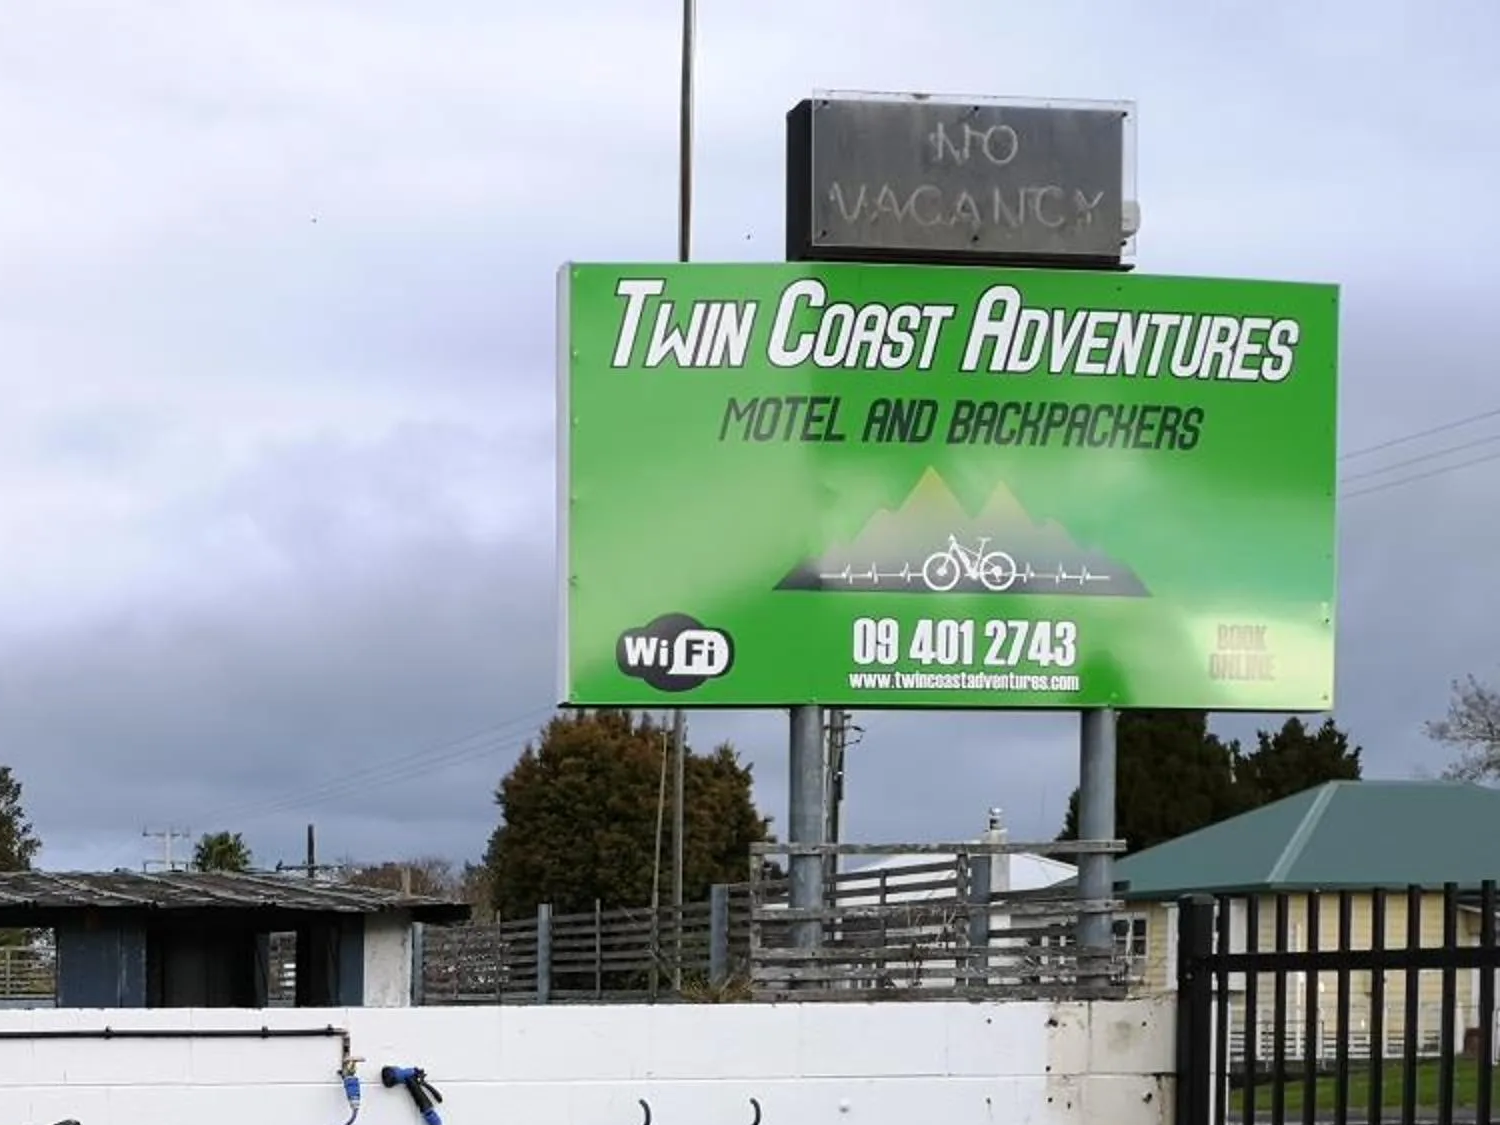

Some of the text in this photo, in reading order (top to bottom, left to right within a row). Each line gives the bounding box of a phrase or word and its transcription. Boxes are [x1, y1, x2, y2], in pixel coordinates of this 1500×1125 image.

[928, 121, 1019, 166] NO
[829, 181, 1105, 227] VACANCY
[611, 278, 1301, 382] TWIN COAST ADVENTURES
[718, 396, 1205, 451] MOTEL AND BACKPACKERS
[853, 617, 1078, 667] 09 401 2743
[848, 670, 1080, 692] www.twincoastadventures.com
